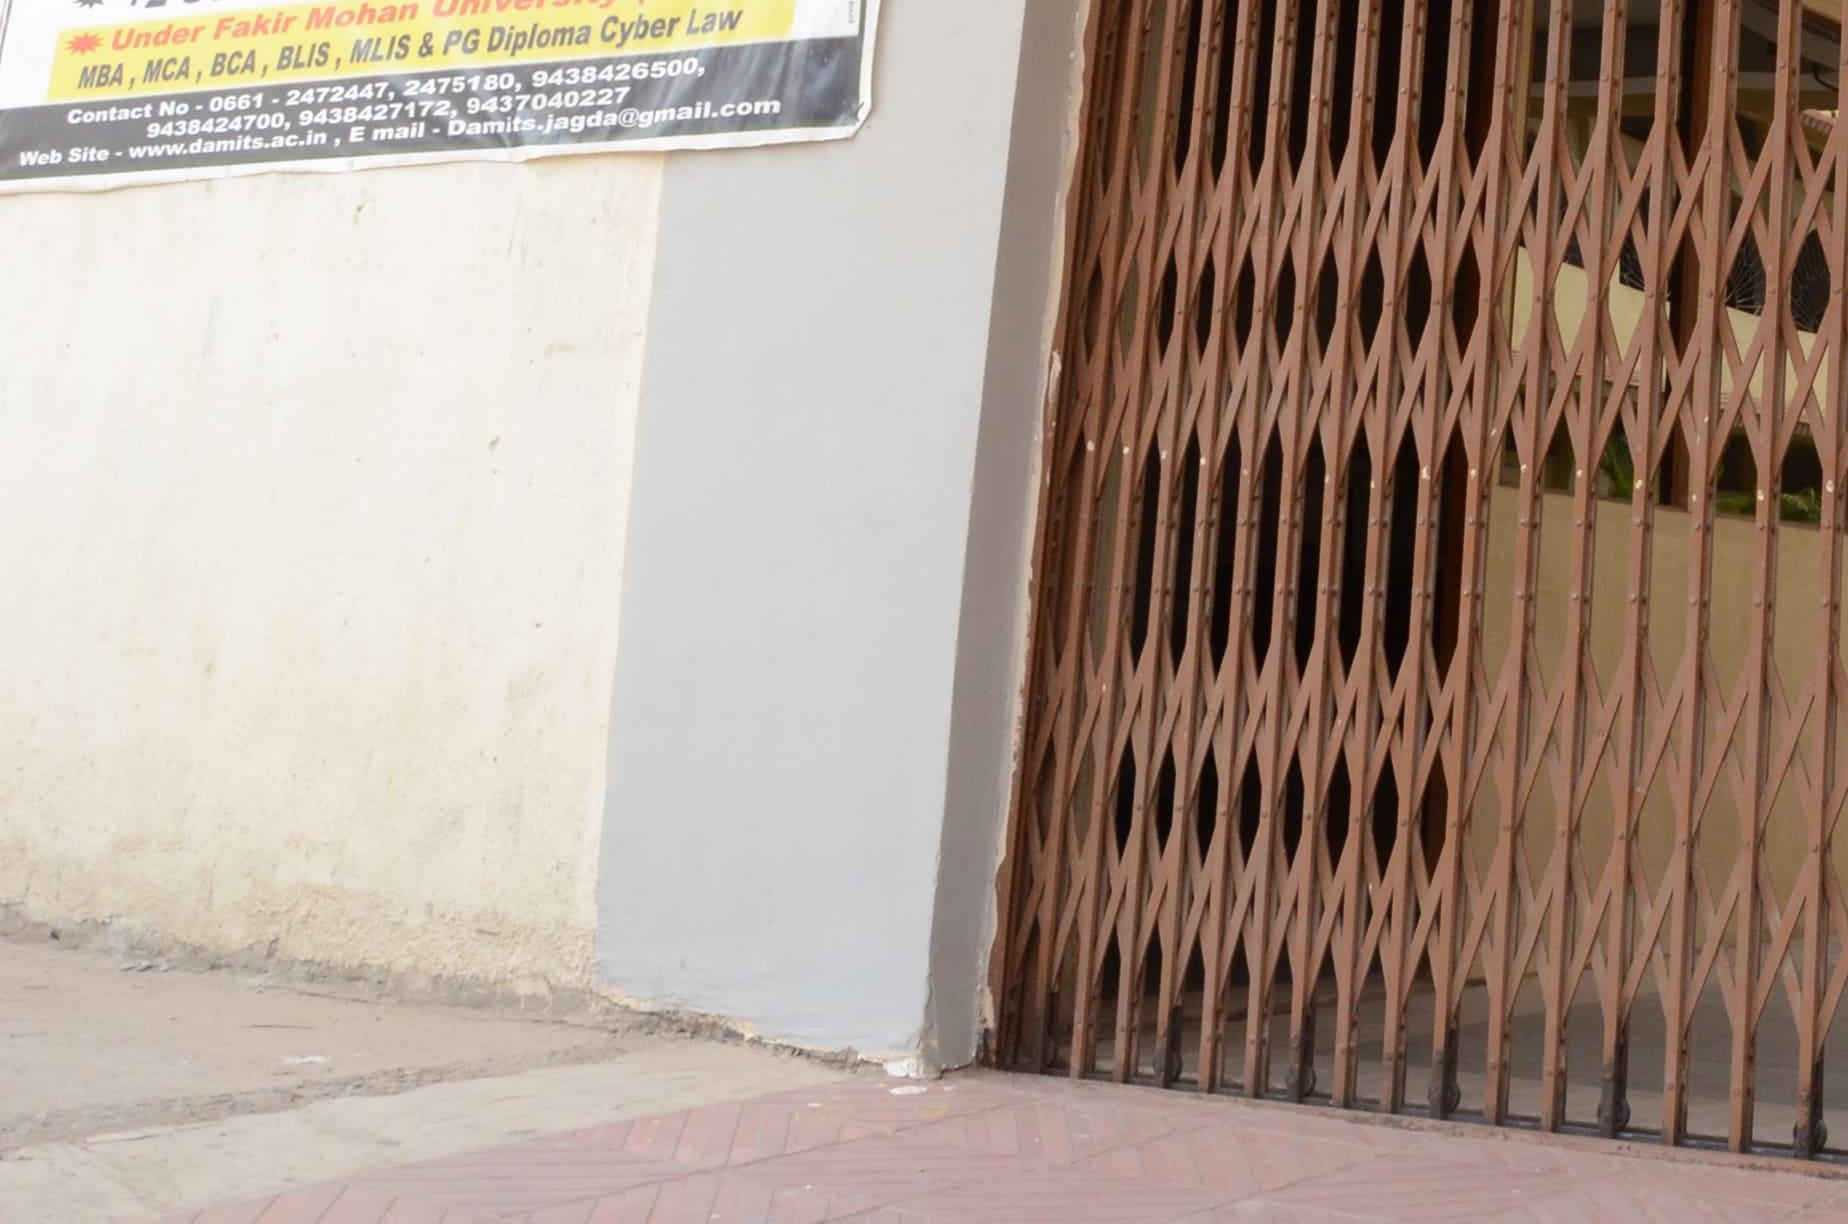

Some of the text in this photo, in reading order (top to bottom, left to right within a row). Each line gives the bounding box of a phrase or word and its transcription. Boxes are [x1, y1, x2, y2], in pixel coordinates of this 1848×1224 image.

[77, 63, 123, 89] MBA
[143, 56, 190, 84] MCA
[210, 49, 256, 77] BCA
[276, 42, 331, 71] BLIS
[350, 34, 411, 64] MLIS
[418, 31, 433, 58] &
[443, 28, 480, 56] PG
[488, 22, 591, 57] Diploma
[600, 13, 680, 46] Cyber
[686, 7, 743, 36] Law
[111, 20, 205, 50] Under
[213, 11, 298, 41] Fakir
[304, 2, 419, 31] Mohan
[67, 103, 153, 124] Contact
[159, 101, 189, 118] No
[209, 93, 263, 113] 0661
[287, 81, 395, 107] 2472447,
[403, 72, 522, 96] 2475180,
[531, 57, 706, 87] 9438426500,
[146, 87, 632, 138] 9438424700, 9438427172, 9437040227
[20, 149, 62, 166] Web
[68, 146, 109, 163] Site
[129, 129, 327, 160] www.damits.ac.in
[372, 122, 425, 141] mail
[447, 97, 781, 138] Damits.jagda@gmail.com
